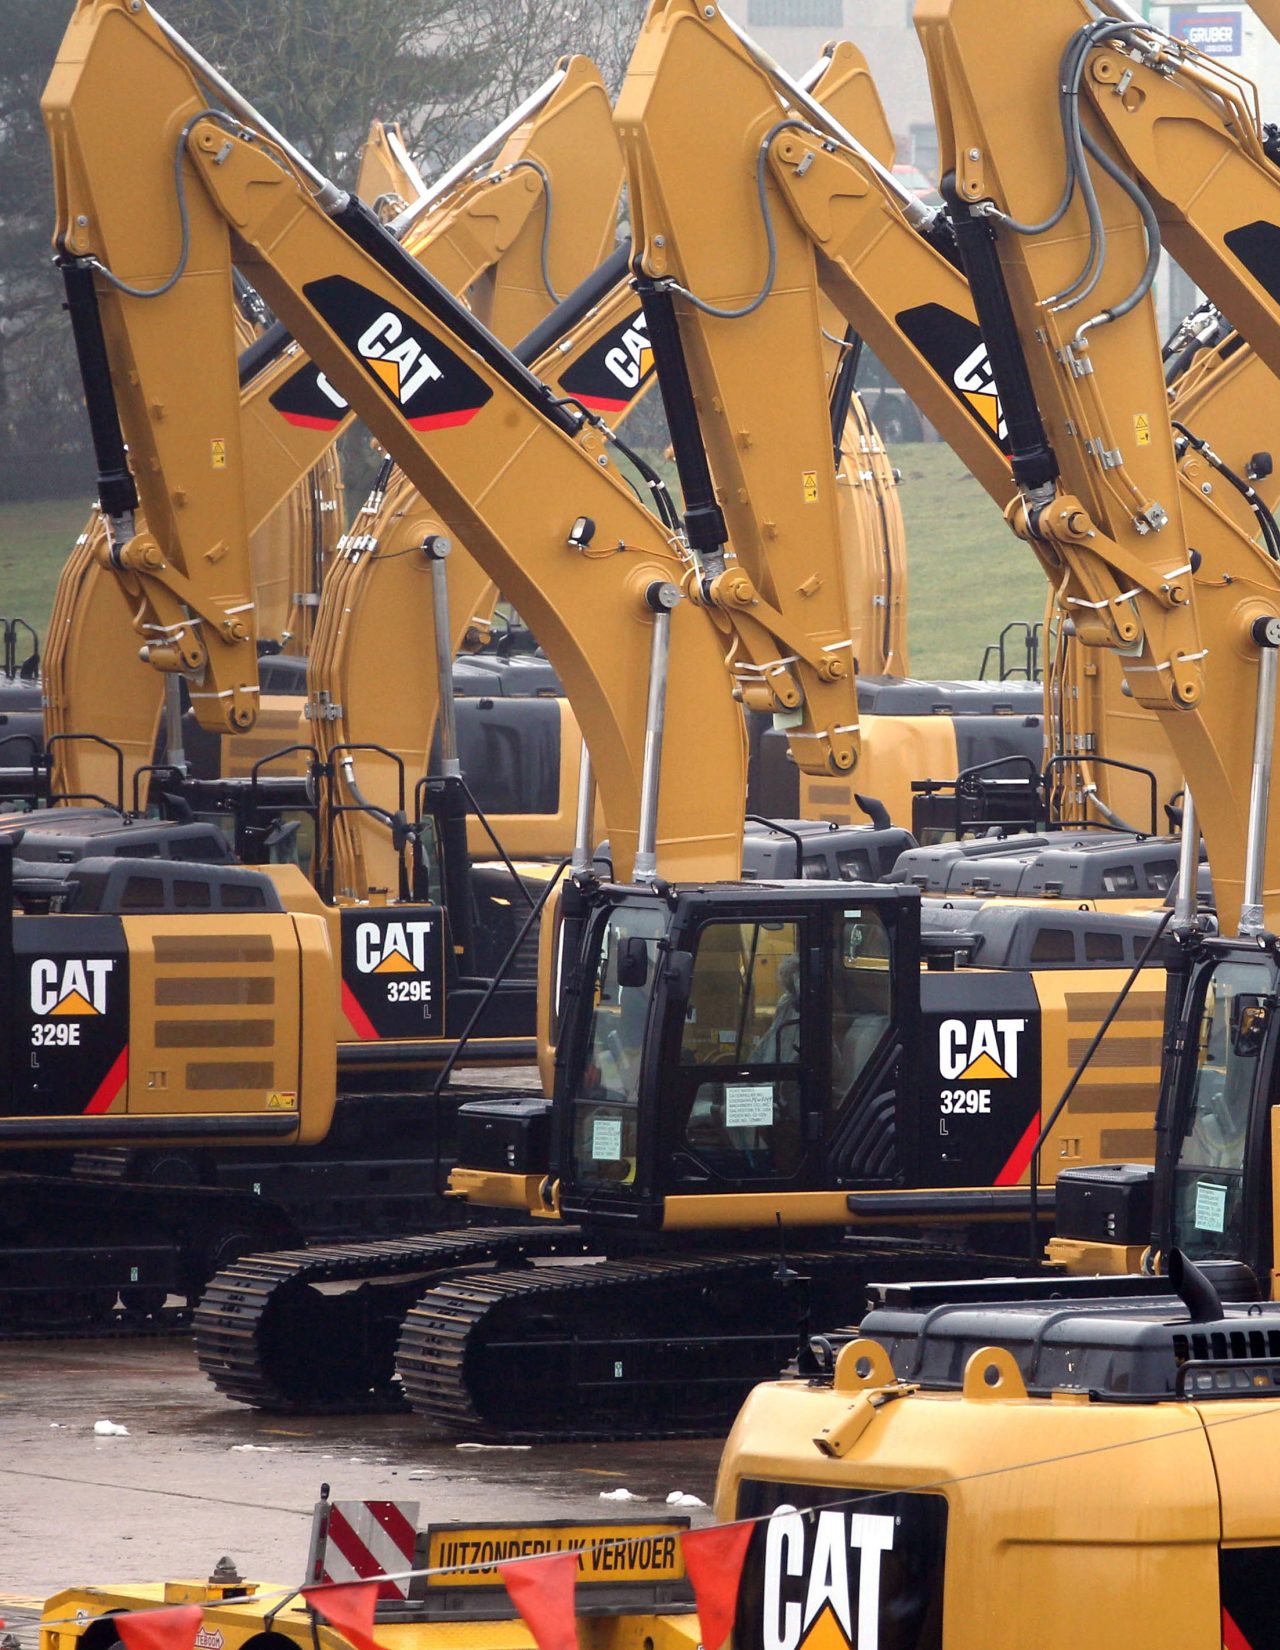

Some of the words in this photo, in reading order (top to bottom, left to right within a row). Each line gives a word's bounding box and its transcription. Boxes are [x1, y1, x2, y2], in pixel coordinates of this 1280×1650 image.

[1189, 27, 1233, 42] GRUBER
[358, 311, 442, 404] CAT
[604, 311, 652, 388] CA
[356, 921, 431, 973] CAT
[30, 958, 113, 1015] CAT
[387, 980, 432, 1002] 329E
[423, 1004, 431, 1019] L
[31, 1023, 80, 1046] 329E
[939, 1018, 1025, 1080] CAT
[31, 1051, 39, 1068] L
[940, 1089, 991, 1114] 329E
[939, 1118, 948, 1136] L
[591, 1536, 676, 1571] VERVOER
[763, 1504, 895, 1650] CAT
